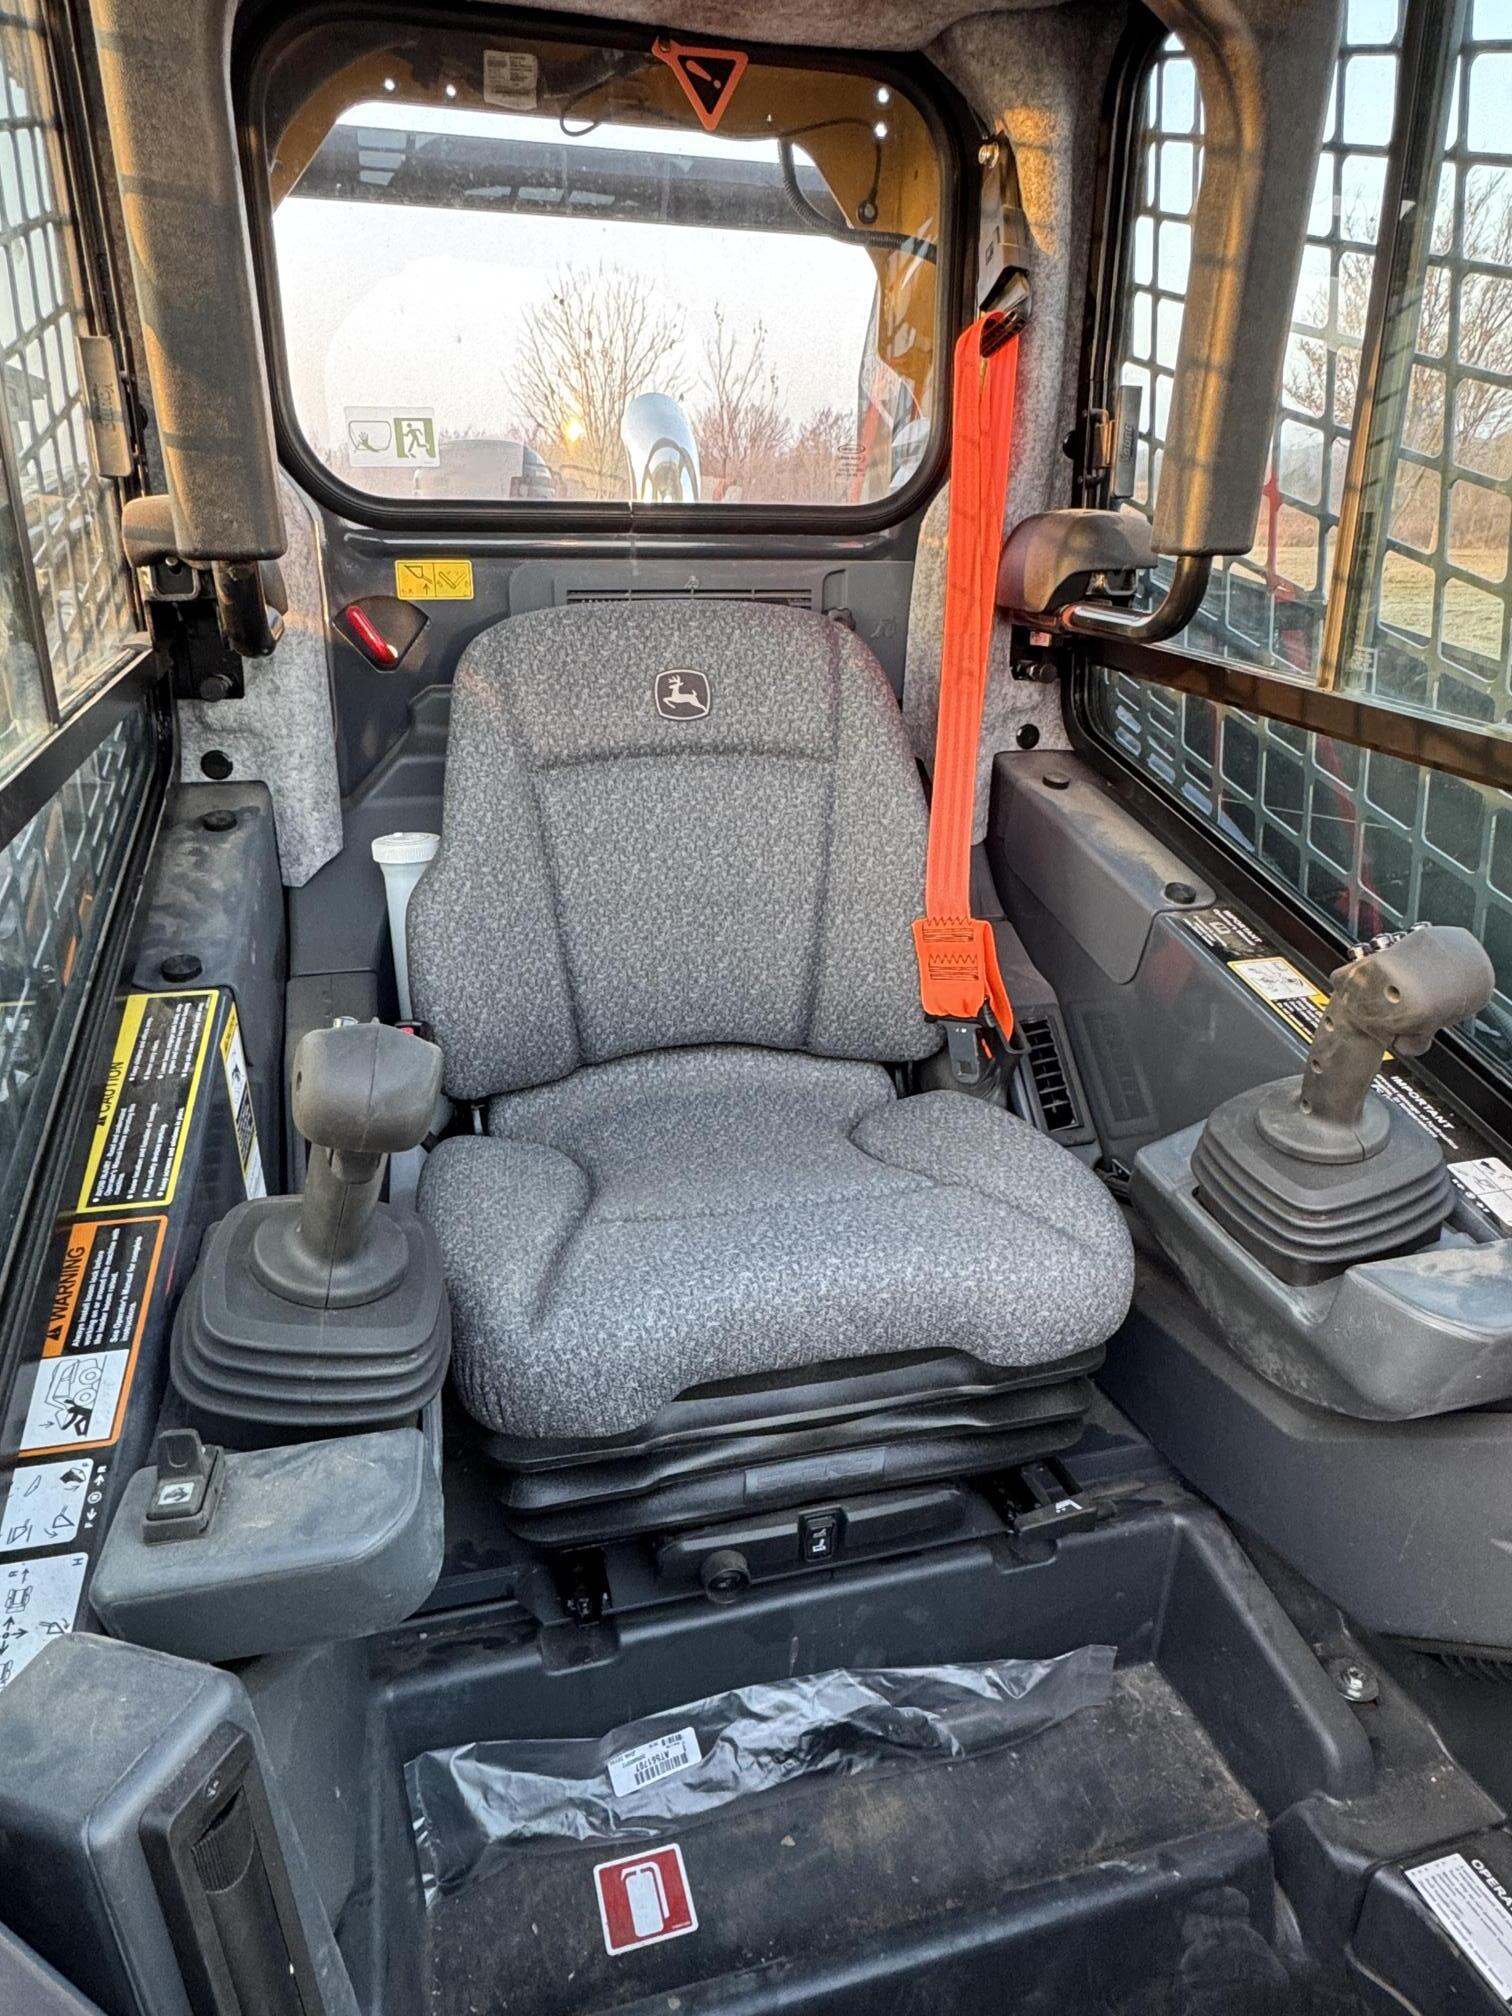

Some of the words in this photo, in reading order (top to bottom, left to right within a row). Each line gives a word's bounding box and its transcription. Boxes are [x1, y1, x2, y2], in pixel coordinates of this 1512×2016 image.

[1221, 907, 1263, 945] IMPORTANT
[99, 1060, 123, 1113] CAUTION
[1387, 1072, 1456, 1133] IMPORTANT
[92, 1249, 104, 1269] before
[127, 1262, 135, 1272] for
[88, 1269, 99, 1283] lock
[100, 1265, 110, 1278] this
[49, 1245, 84, 1322] WARNING
[83, 1283, 95, 1302] boom
[95, 1278, 107, 1300] around
[121, 1272, 133, 1295] Manual
[78, 1302, 90, 1322] install
[91, 1309, 98, 1318] on
[93, 1300, 101, 1308] or
[112, 1294, 129, 1329] Operator's
[93, 1332, 102, 1345] the
[102, 1292, 113, 1311] boom
[71, 1322, 85, 1347] Always
[83, 1318, 97, 1346] working
[109, 1329, 119, 1343] See
[1472, 1859, 1512, 1912] OPERA
